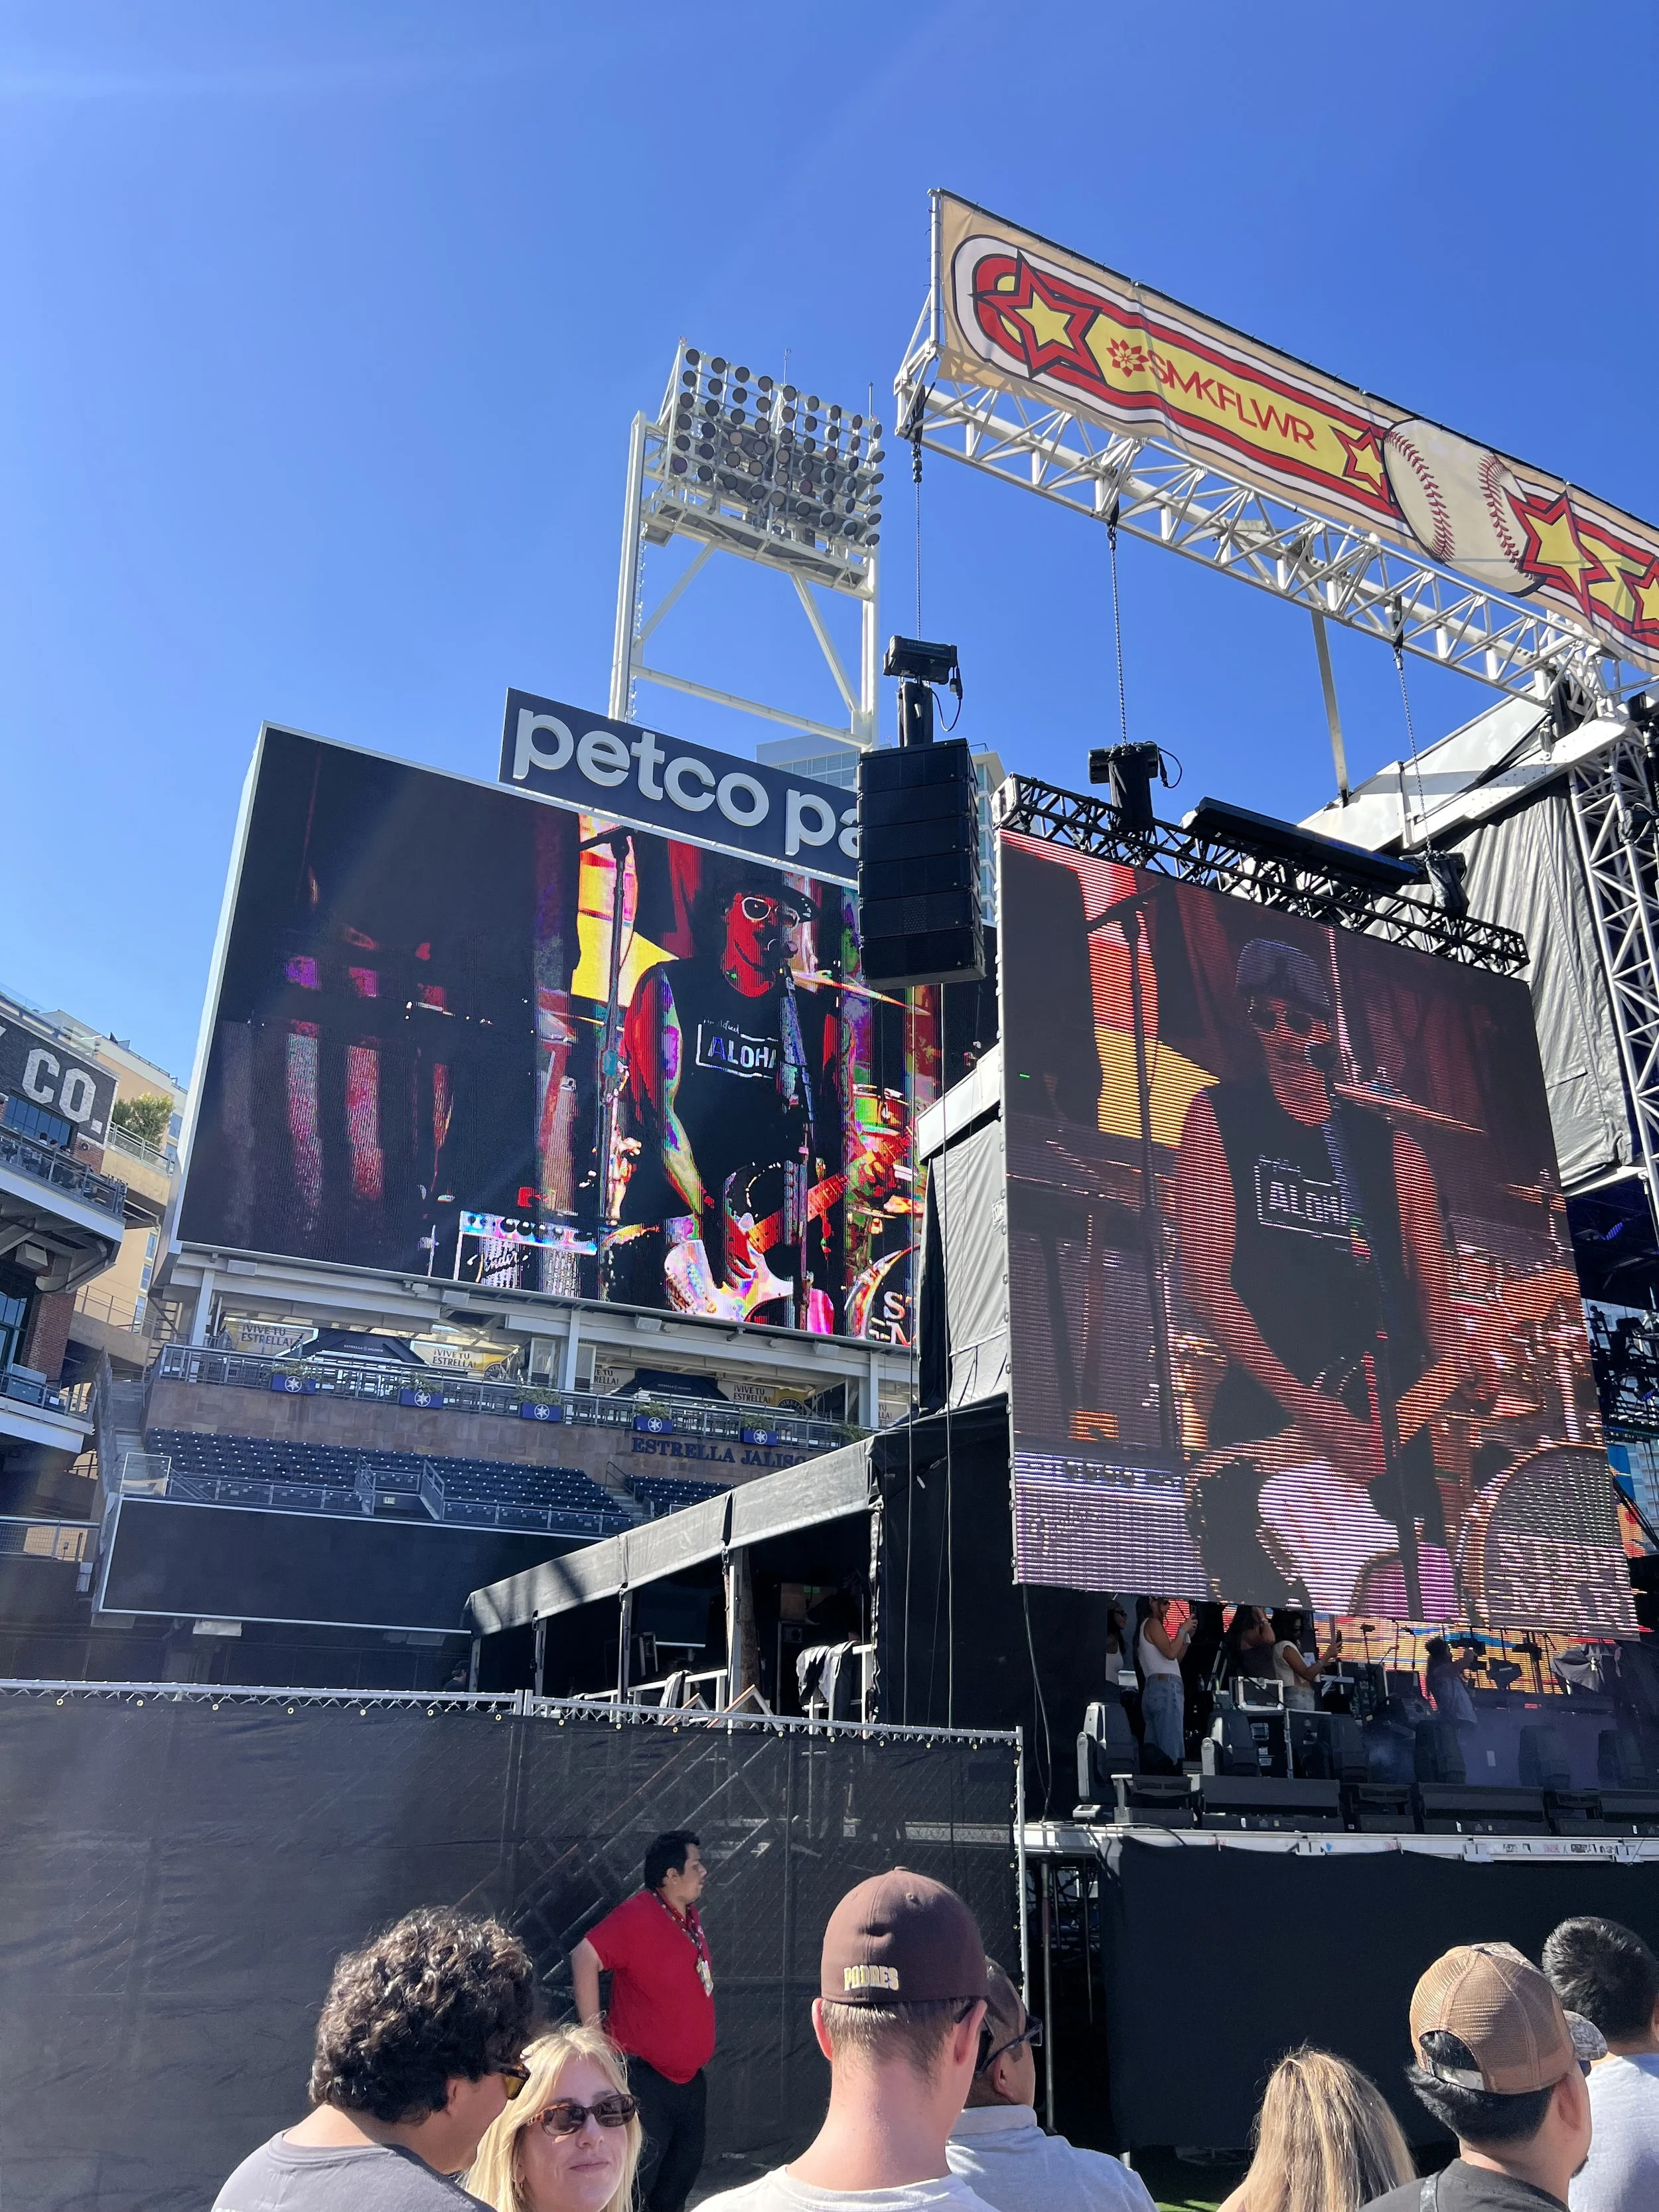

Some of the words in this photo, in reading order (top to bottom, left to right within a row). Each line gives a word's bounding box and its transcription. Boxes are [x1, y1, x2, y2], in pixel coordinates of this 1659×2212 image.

[1147, 349, 1319, 452] SMKFLWR
[512, 707, 770, 828] petco
[21, 1048, 104, 1135] CO.
[273, 1327, 286, 1337] TU
[755, 1387, 765, 1396] TU
[631, 1437, 736, 1463] ESTRELLA
